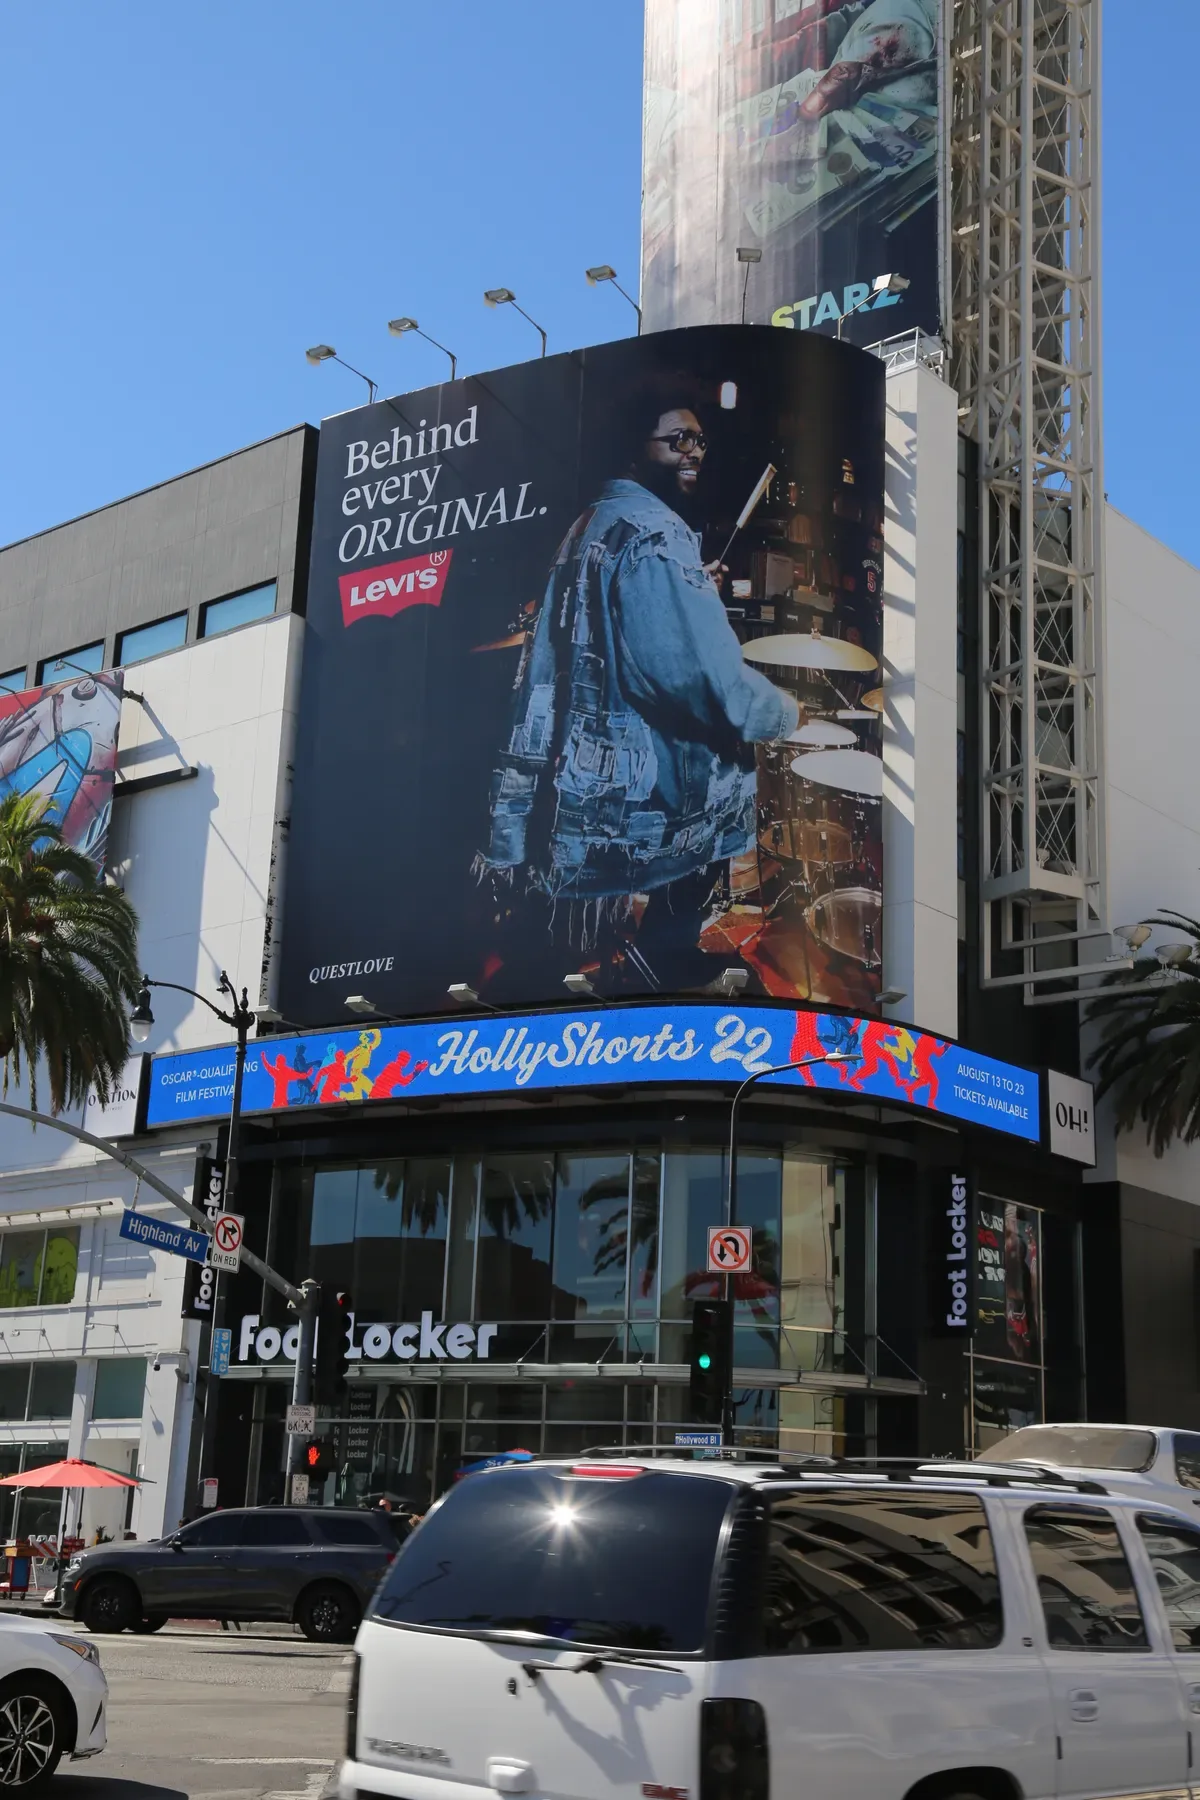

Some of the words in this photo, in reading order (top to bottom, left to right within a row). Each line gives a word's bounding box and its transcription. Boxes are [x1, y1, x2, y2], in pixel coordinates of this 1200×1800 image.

[344, 405, 479, 479] Behind
[341, 464, 442, 516] every
[338, 481, 548, 563] ORIGINAL.
[867, 571, 877, 593] 5
[309, 956, 394, 984] QUESTLOVE
[429, 1021, 703, 1086] HollyShorts
[710, 1014, 774, 1077] 22
[175, 1091, 197, 1104] FILM
[199, 1085, 236, 1100] FESTIVA
[957, 1064, 990, 1084] AUGUST
[991, 1075, 1001, 1088] 13
[1002, 1078, 1014, 1092] TO
[1014, 1083, 1025, 1096] 23
[953, 1085, 986, 1106] TICKETS
[987, 1096, 1029, 1120] AVAILABLE
[1055, 1102, 1089, 1133] OH!
[946, 1174, 967, 1261] Locker
[128, 1217, 182, 1248] Highland
[184, 1236, 201, 1253] Av
[213, 1253, 223, 1264] ON
[224, 1256, 237, 1267] RED
[946, 1269, 967, 1327] Foot
[219, 1331, 230, 1372] SYNC
[347, 1437, 369, 1446] Locker
[348, 1426, 369, 1434] Locker
[679, 1435, 709, 1445] Hollywood
[346, 1450, 368, 1458] Locker
